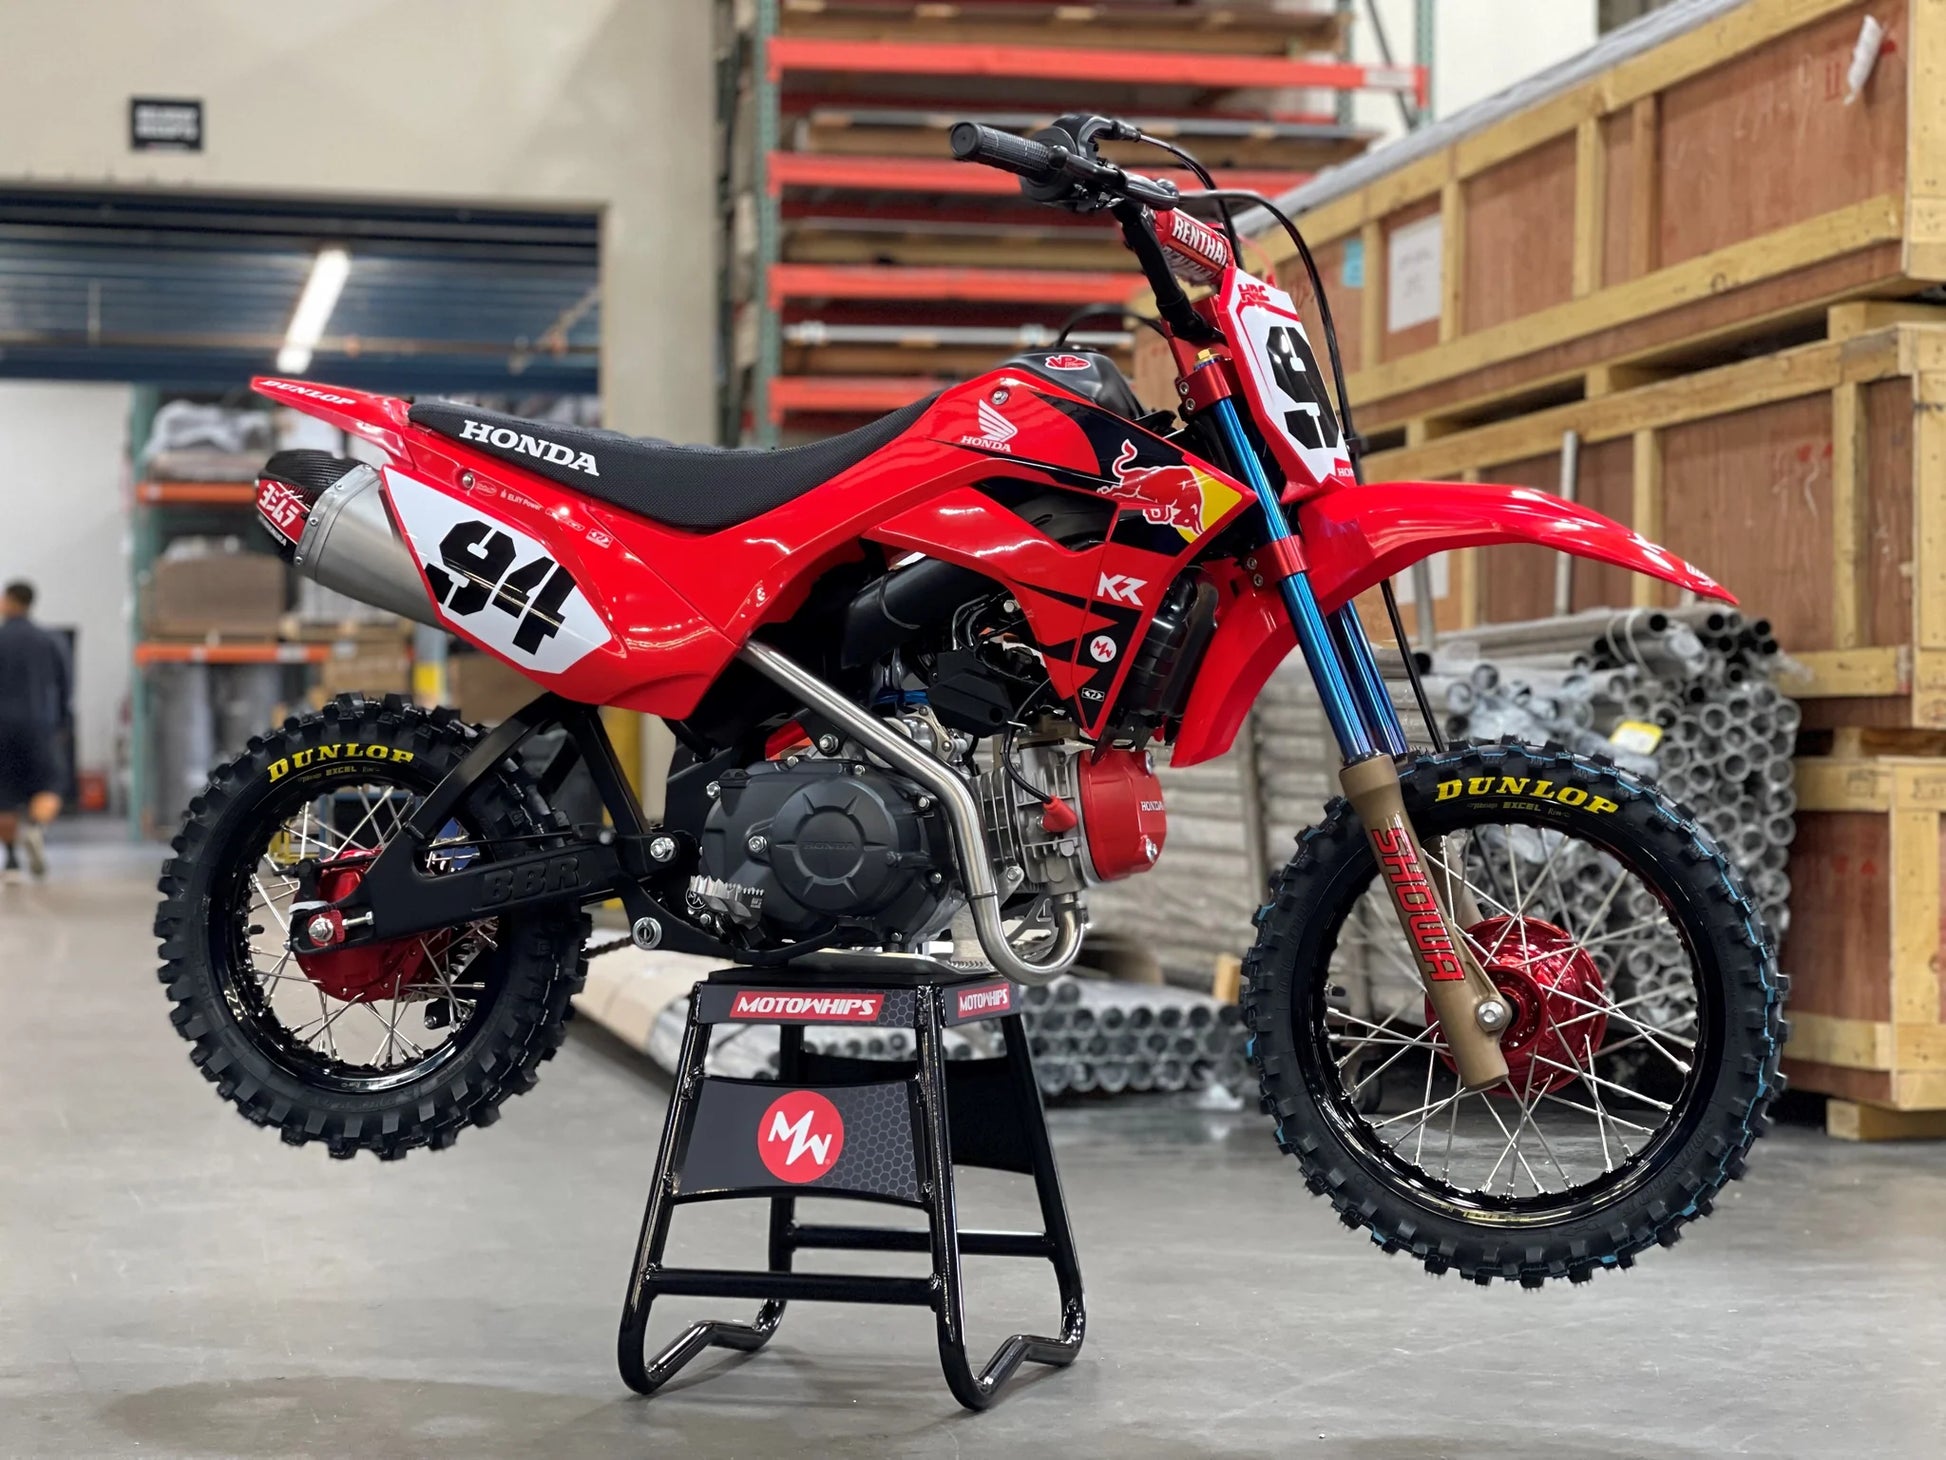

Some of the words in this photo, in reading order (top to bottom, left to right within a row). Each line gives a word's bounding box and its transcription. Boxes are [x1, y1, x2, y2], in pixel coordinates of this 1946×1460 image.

[259, 380, 357, 405] DUNLOP
[1266, 326, 1340, 450] 9
[459, 419, 600, 477] HONDA
[960, 435, 1012, 453] HONDA
[424, 520, 577, 656] 94
[267, 743, 415, 783] DUNLOP
[1140, 800, 1166, 811] HONDA
[1435, 776, 1620, 815] DUNLOP
[1502, 801, 1542, 812] EXCEL
[1371, 828, 1467, 982] SHOWA
[736, 996, 877, 1016] MOTOWHIPS
[959, 987, 1008, 1012] MOTOWHIPS
[767, 1110, 833, 1166] MW
